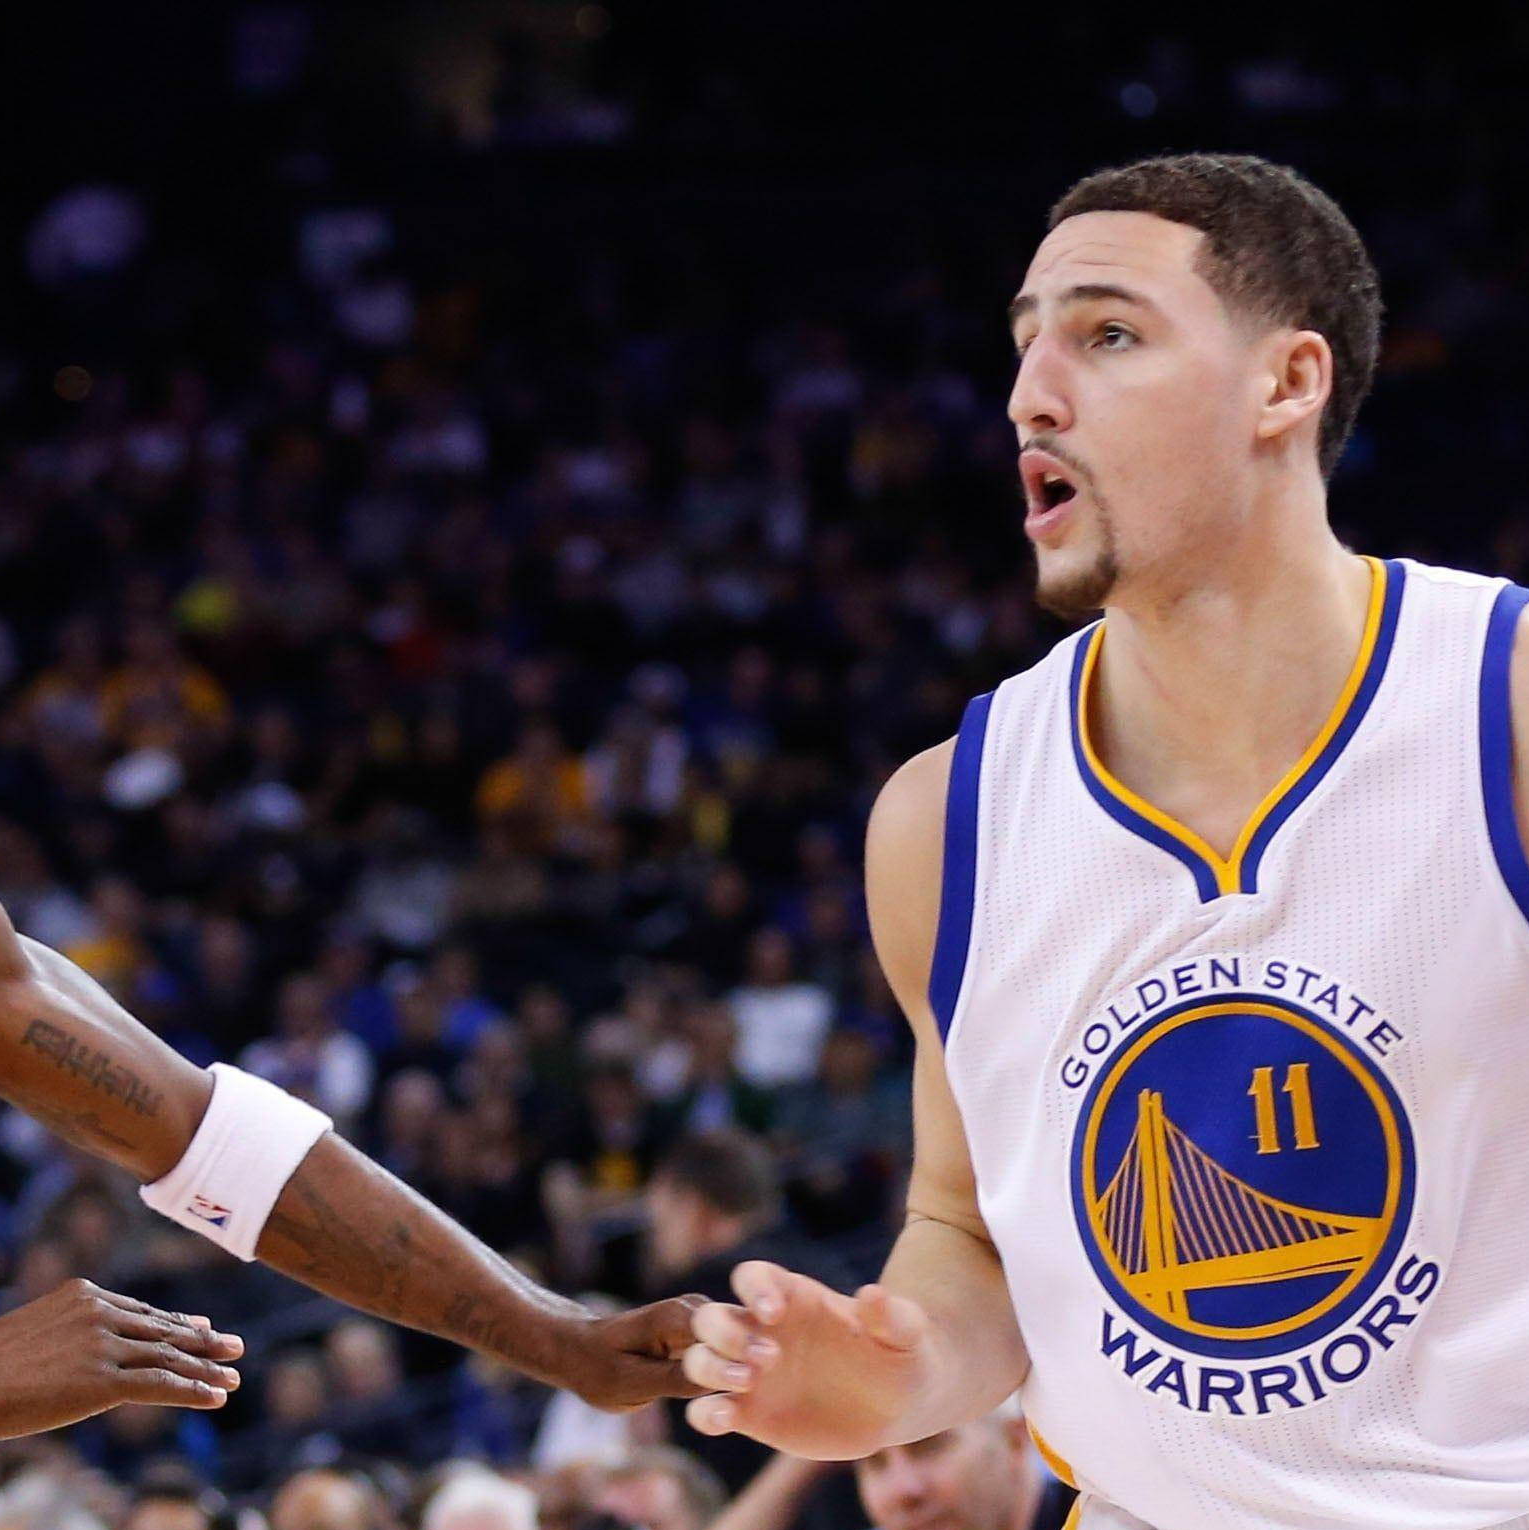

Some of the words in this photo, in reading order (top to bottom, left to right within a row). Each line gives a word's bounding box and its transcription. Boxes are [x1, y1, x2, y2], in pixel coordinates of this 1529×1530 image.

[1061, 957, 1241, 1089] GOLDEN
[1264, 960, 1402, 1056] STATE
[1247, 1063, 1320, 1155] 11
[1100, 1254, 1440, 1416] WARRIORS
